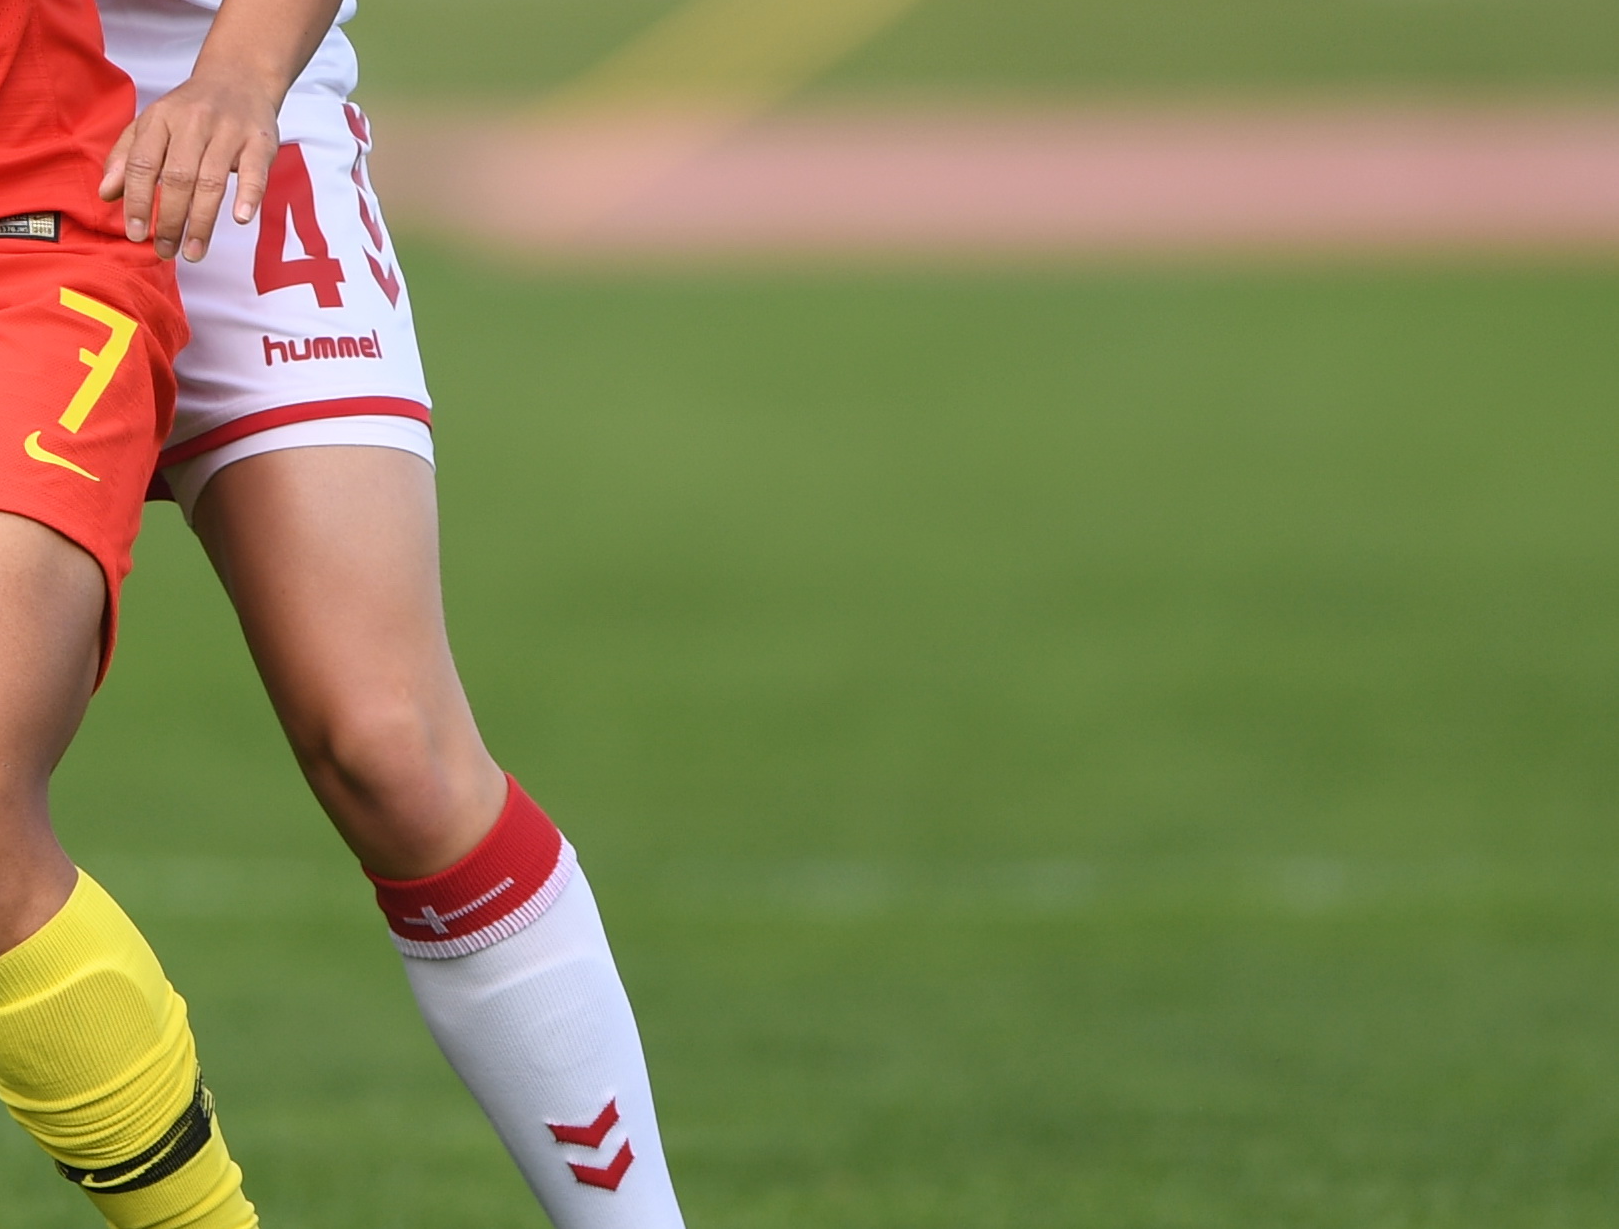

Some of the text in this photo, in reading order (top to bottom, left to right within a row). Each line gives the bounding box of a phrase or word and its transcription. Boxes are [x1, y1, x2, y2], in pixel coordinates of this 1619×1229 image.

[253, 142, 345, 309] 4
[59, 286, 138, 434] 7
[262, 328, 383, 367] hummel
